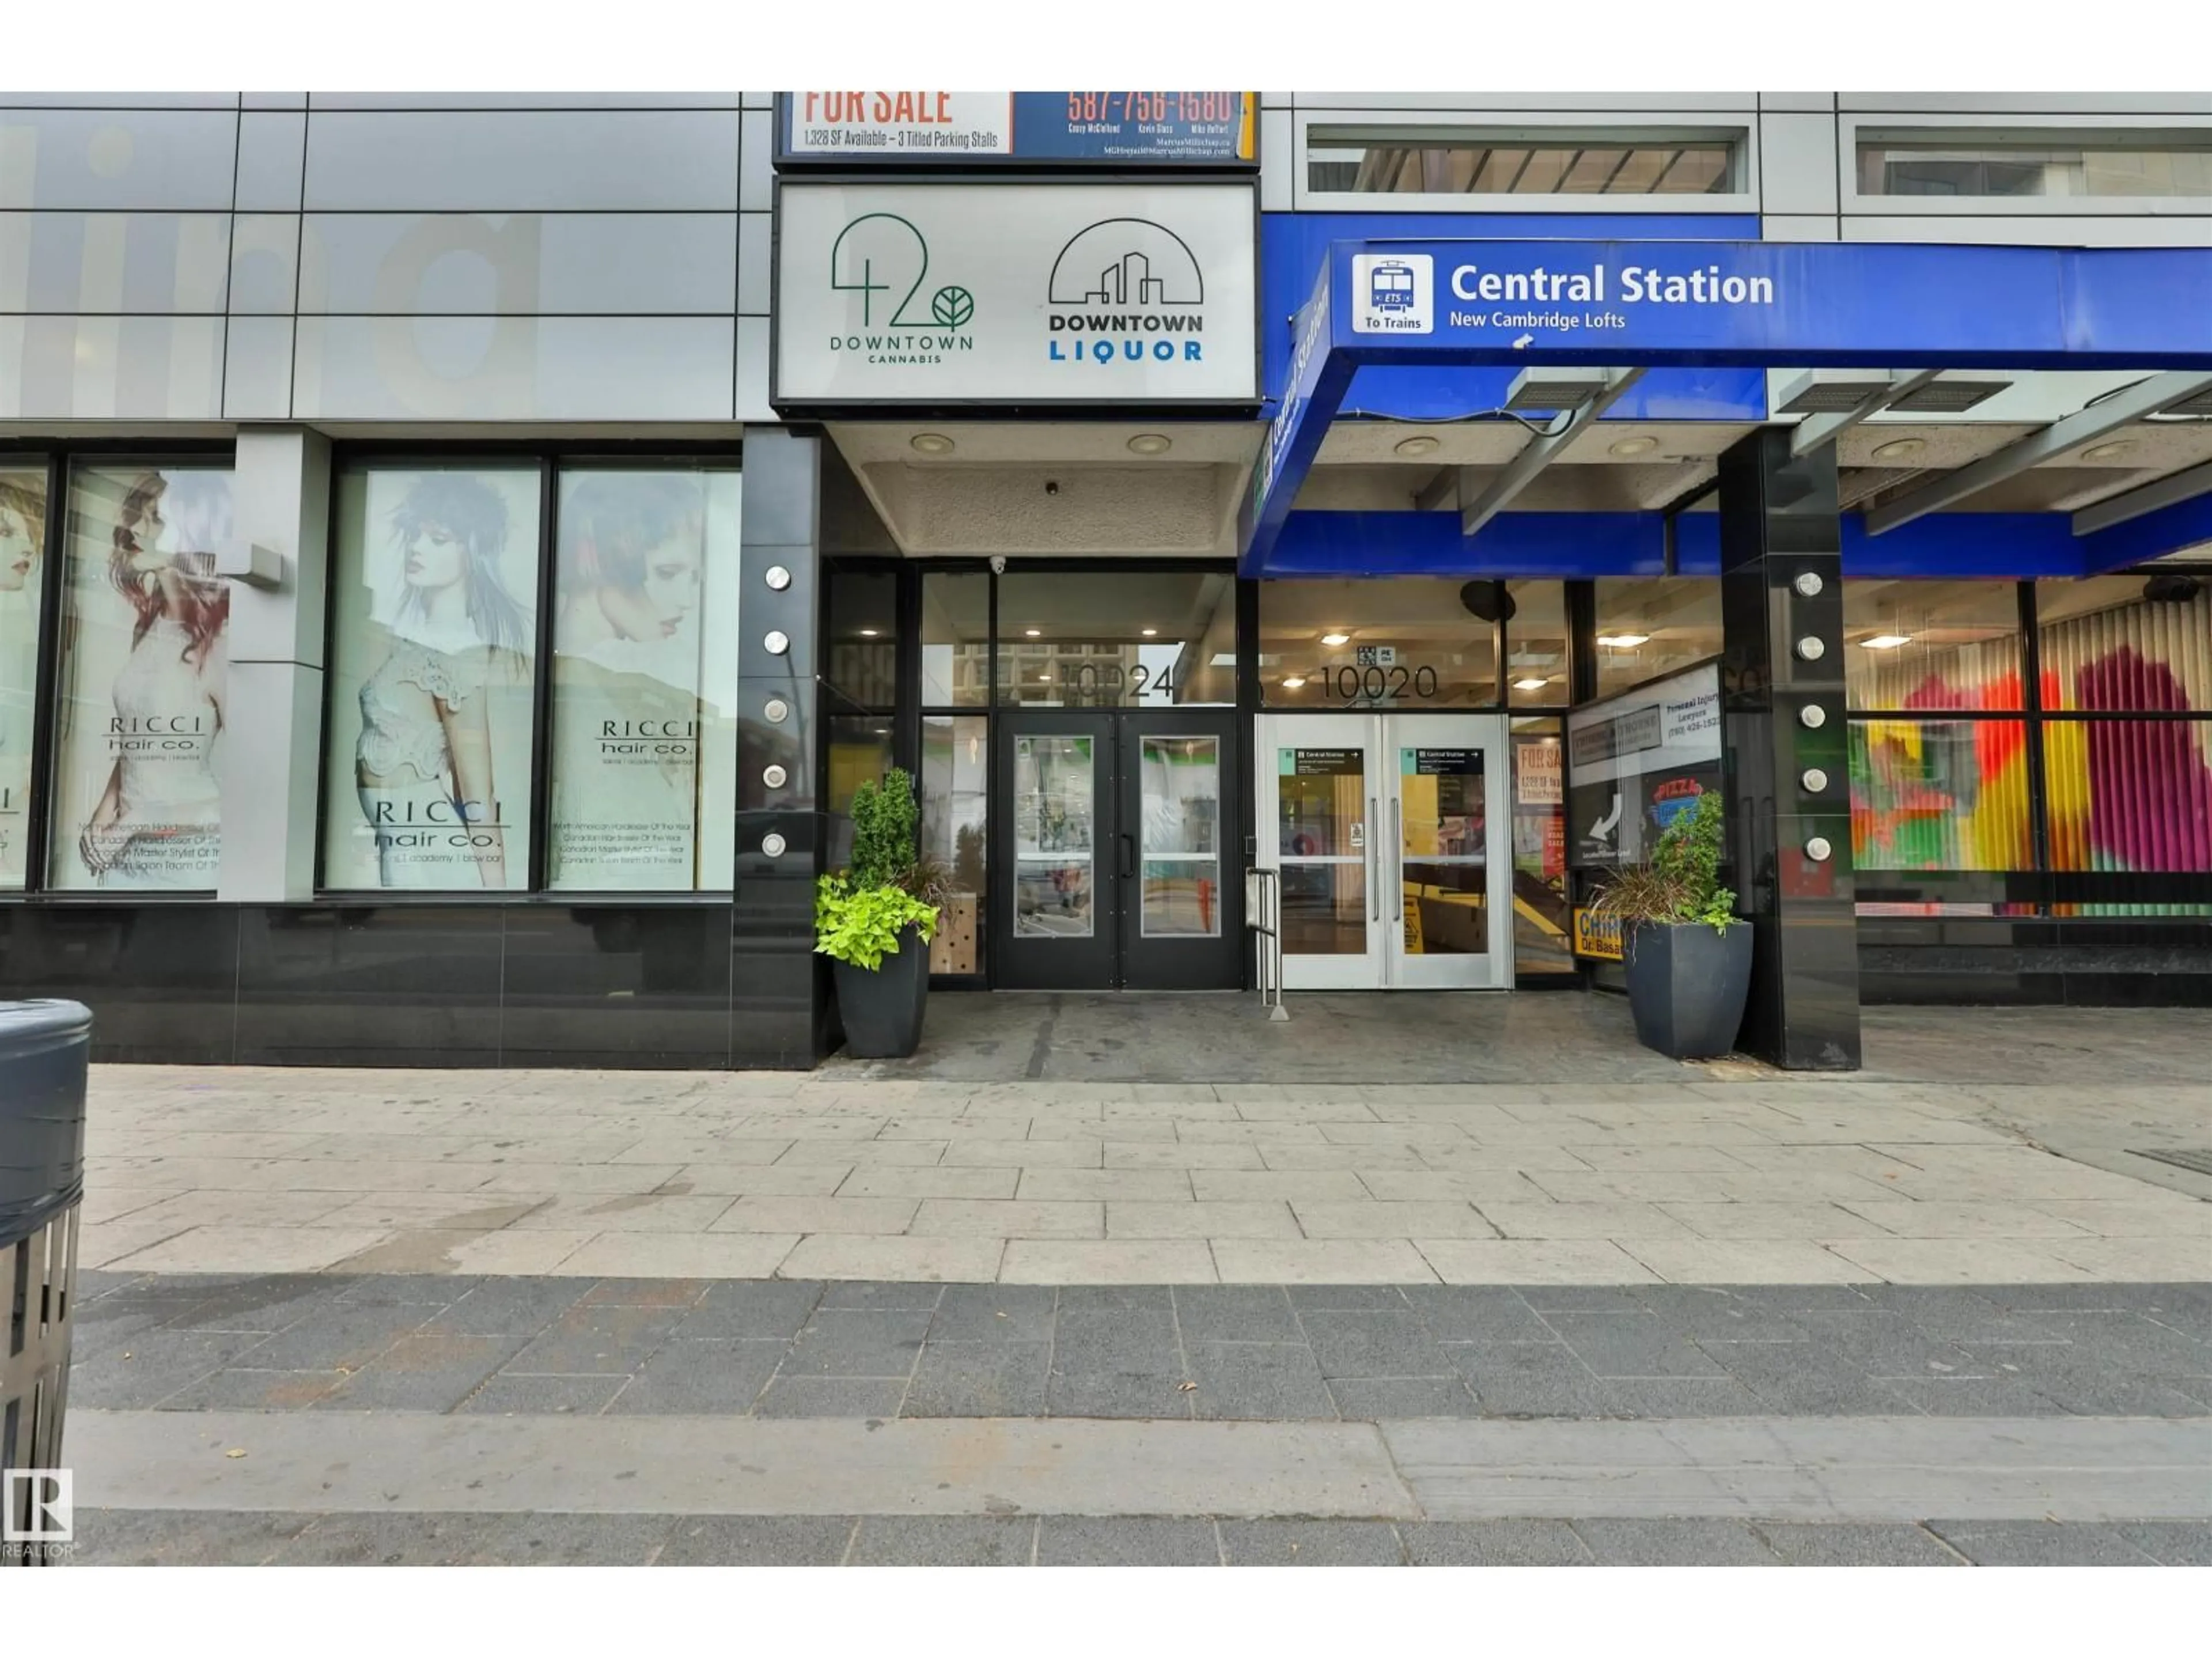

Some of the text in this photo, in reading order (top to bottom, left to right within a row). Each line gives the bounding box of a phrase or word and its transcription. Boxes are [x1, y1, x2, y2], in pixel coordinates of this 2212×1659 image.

[806, 92, 952, 123] FOR SALE
[831, 130, 842, 146] SF
[844, 130, 887, 146] Available
[899, 131, 903, 146] 3
[907, 131, 931, 147] Titled
[934, 131, 969, 150] Parking
[972, 132, 998, 147] Stalls
[1451, 264, 1773, 304] Central Station
[1049, 315, 1203, 332] DOWNTOWN
[1365, 316, 1421, 328] To Trains
[1450, 311, 1626, 332] New Cambridge Lofts
[831, 336, 973, 350] DOWNTOWN
[1050, 340, 1202, 364] LIQUOR
[868, 355, 942, 363] CANNABIS
[1321, 665, 1437, 699] 10020
[111, 716, 200, 733] RICCI
[603, 720, 692, 737] RICCI
[109, 739, 200, 750] hair co.
[602, 742, 692, 755] hair co.
[1521, 749, 1560, 768] FOR SA
[1658, 777, 1697, 798] PIZZA
[376, 801, 501, 823] RICCI
[374, 832, 501, 847] hair co.
